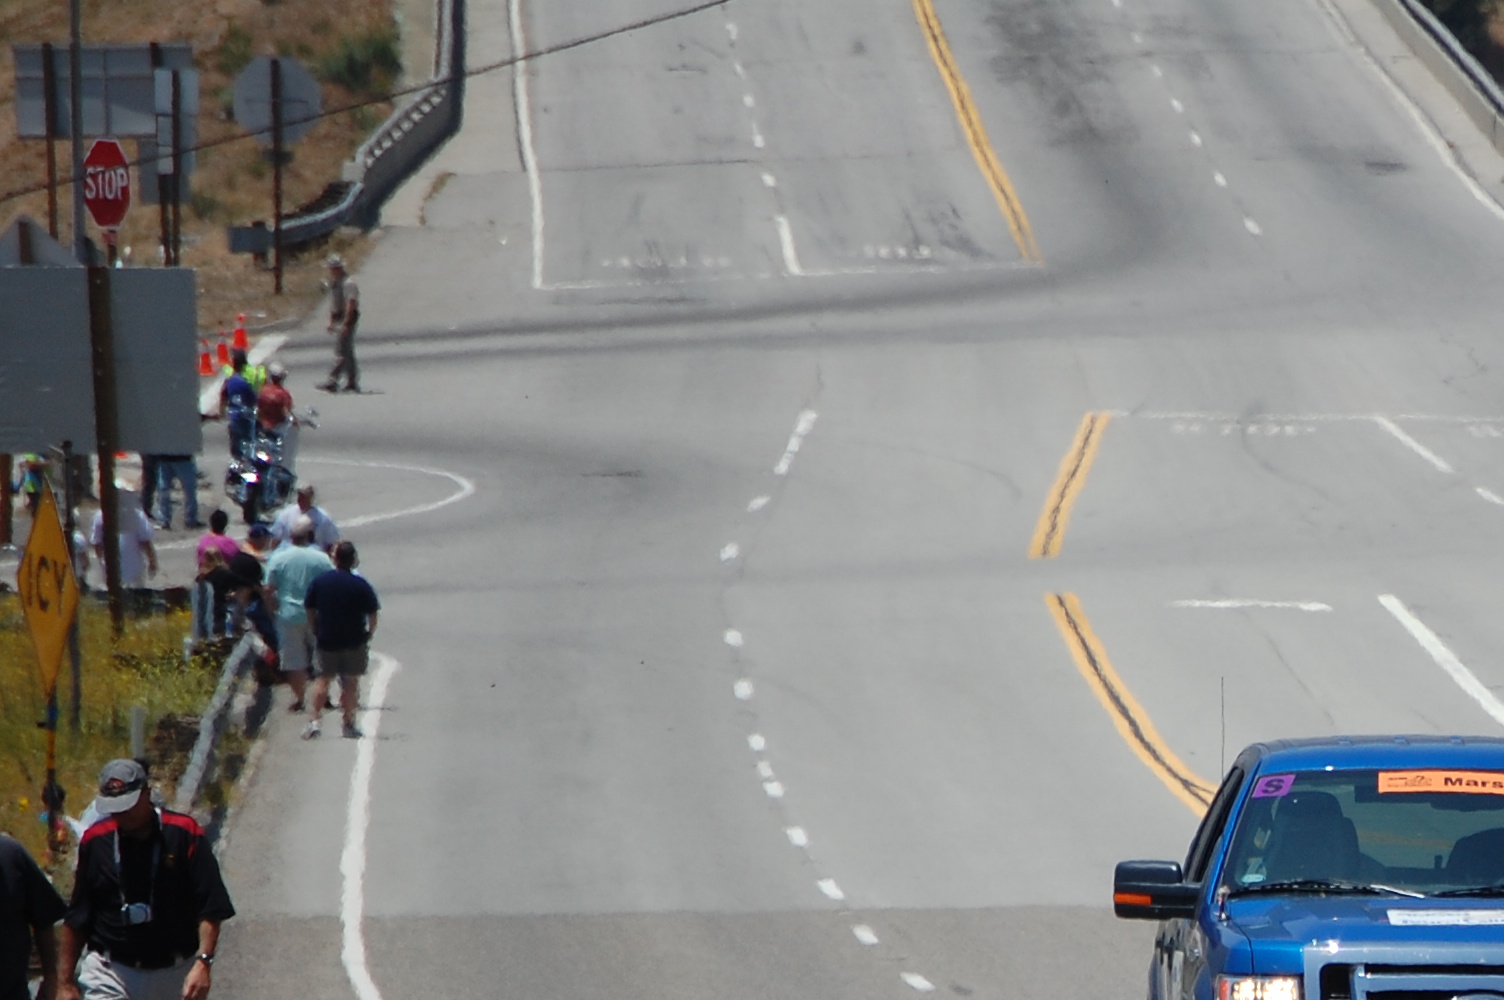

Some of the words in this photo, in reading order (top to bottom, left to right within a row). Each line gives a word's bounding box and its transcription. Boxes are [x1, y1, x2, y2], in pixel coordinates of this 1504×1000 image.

[85, 166, 129, 200] STOP
[28, 552, 67, 617] ICY
[1261, 778, 1285, 795] S
